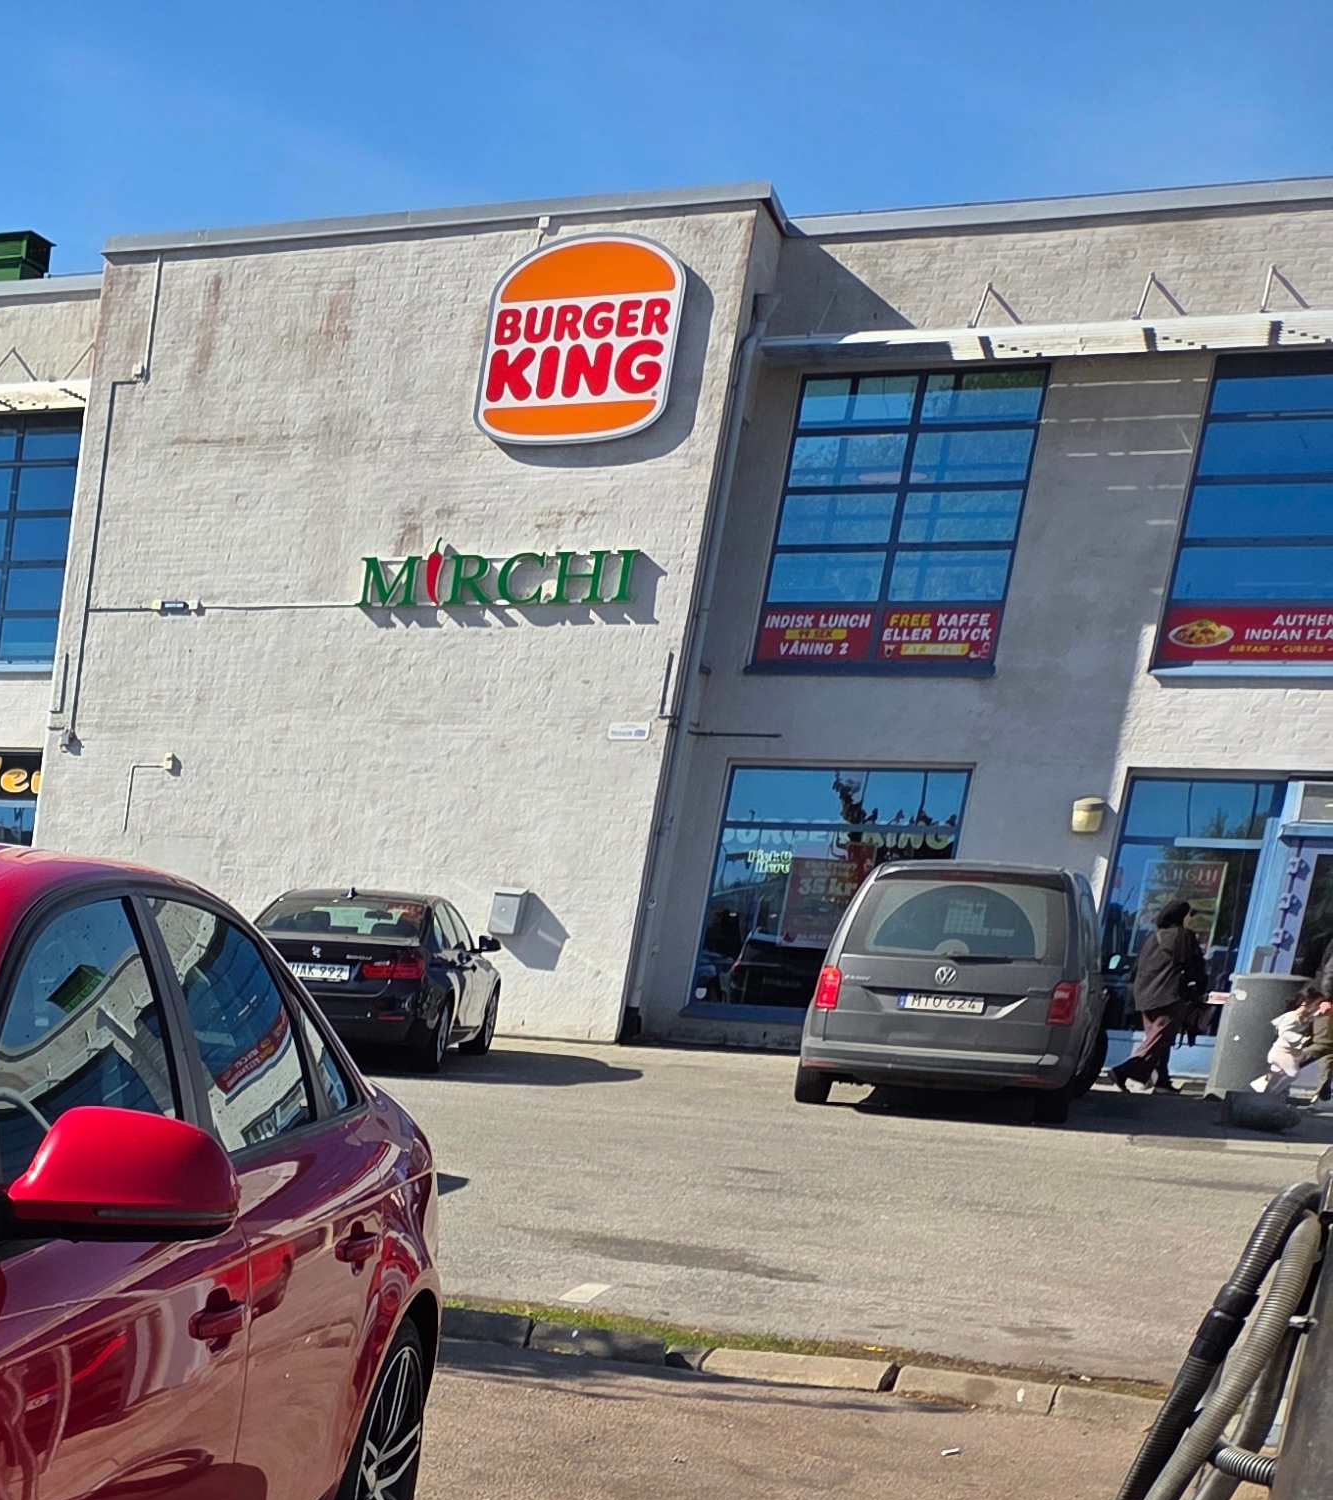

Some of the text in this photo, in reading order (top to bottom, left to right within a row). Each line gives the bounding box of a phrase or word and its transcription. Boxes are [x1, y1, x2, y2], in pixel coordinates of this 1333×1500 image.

[494, 298, 671, 346] BURGER
[486, 339, 664, 402] KING
[355, 540, 640, 606] MIRCHI
[764, 613, 872, 629] INDISK LUNCH
[889, 613, 991, 627] FREE KAFFE
[882, 627, 992, 641] ELLER DRYCK
[1244, 628, 1333, 640] INDIAN FLA
[838, 642, 849, 655] 2
[911, 994, 977, 1010] MTO 624
